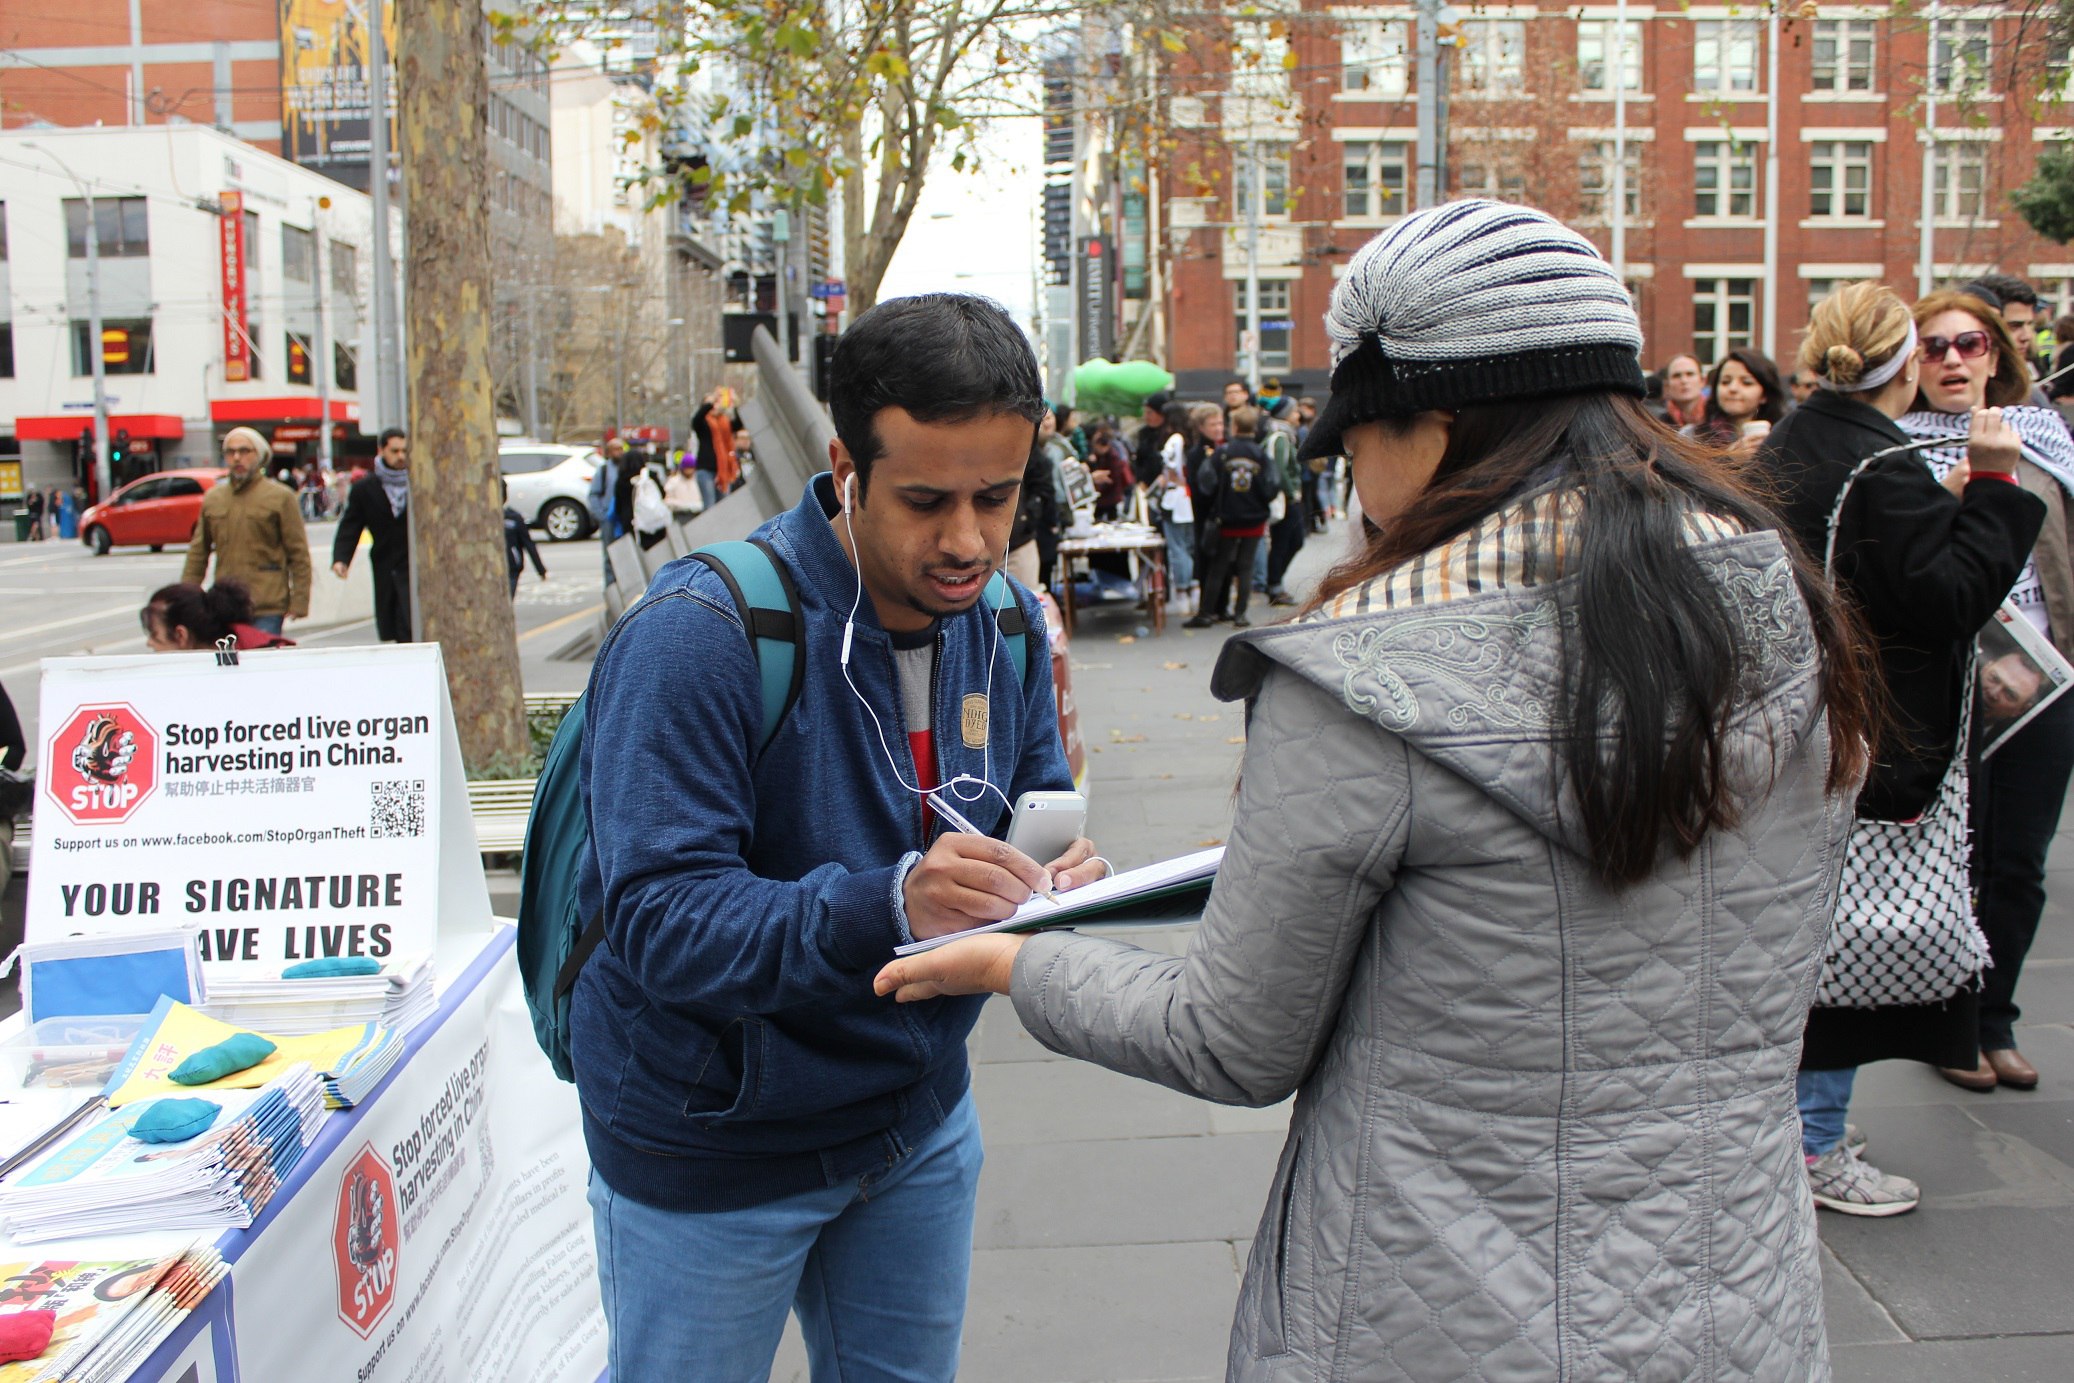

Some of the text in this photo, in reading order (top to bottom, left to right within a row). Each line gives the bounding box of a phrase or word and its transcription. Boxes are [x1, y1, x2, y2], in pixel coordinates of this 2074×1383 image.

[1087, 300, 1103, 358] Universi
[166, 715, 429, 749] Stop forced live organ
[963, 708, 988, 723] NDIG
[965, 719, 986, 731] DYED
[166, 743, 403, 775] harvesting in China.
[70, 785, 138, 812] STOP
[165, 776, 316, 798] 幫助停止中共活摘器官
[54, 826, 366, 852] Support us on www.facebook.com/StopOrganTheft
[62, 873, 403, 917] YOUR SIGNATURE
[199, 924, 392, 961] AVE LIVES
[393, 1038, 489, 1180] Stop forced live org
[399, 1083, 485, 1216] harvesting in Chin
[353, 1248, 395, 1320] STOP
[357, 1343, 386, 1383] Support
[385, 1328, 395, 1348] us
[396, 1316, 405, 1334] on
